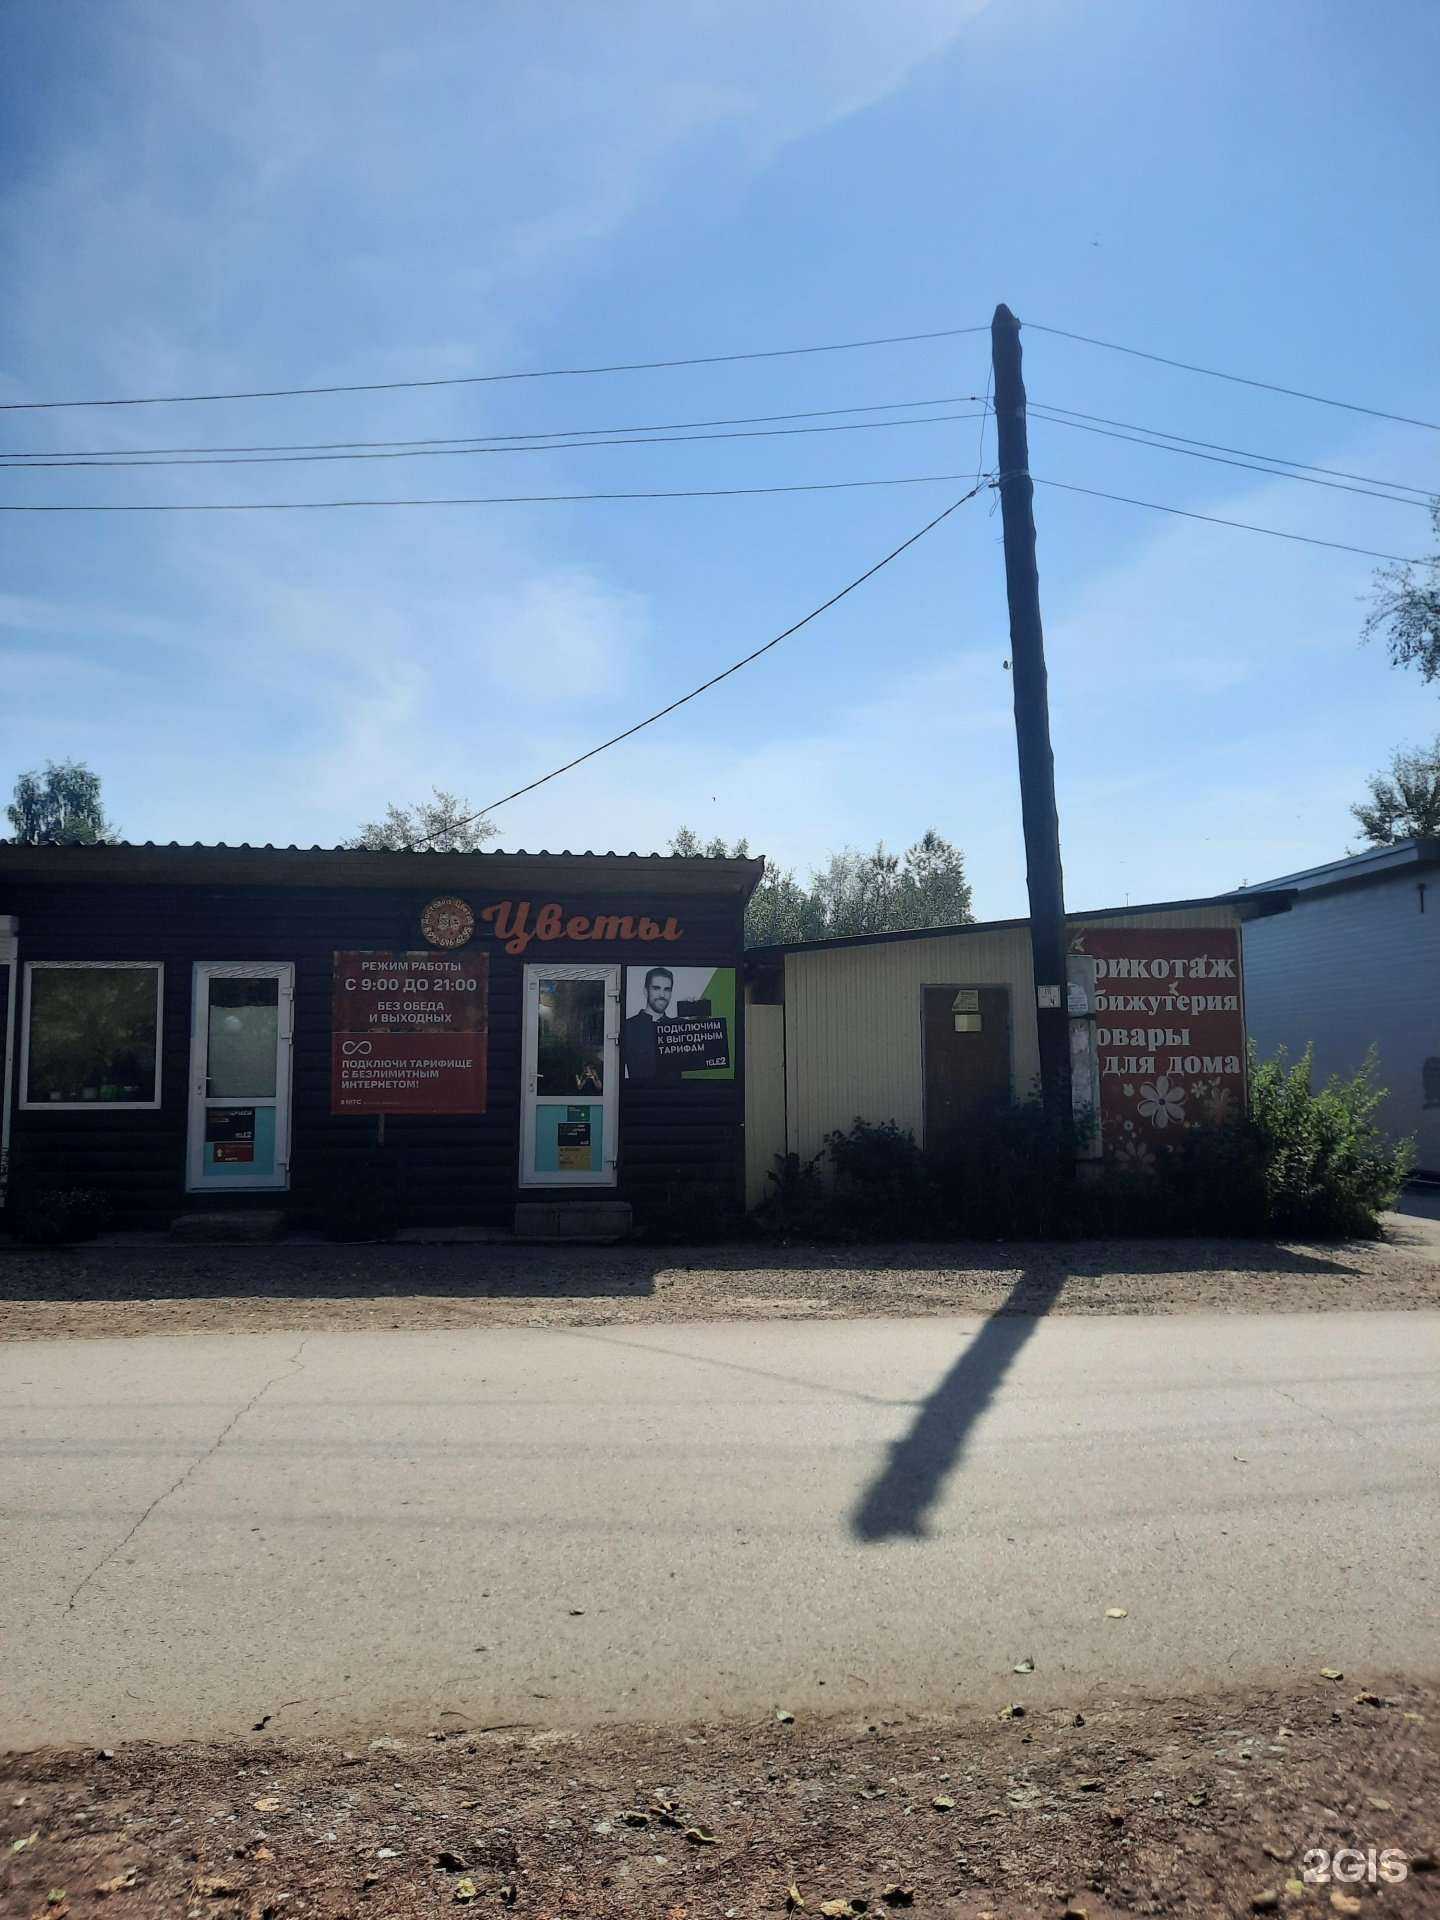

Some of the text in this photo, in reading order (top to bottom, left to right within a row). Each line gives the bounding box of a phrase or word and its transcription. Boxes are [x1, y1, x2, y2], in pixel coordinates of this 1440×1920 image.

[481, 901, 684, 955] Цветы
[361, 961, 461, 971] РЕЖИМ РАБОТЫ
[1094, 958, 1237, 984] рикотаж
[344, 978, 477, 993] С 9:00 ДО 21:00
[377, 1001, 445, 1012] БЕЗ ОБЕДА
[369, 1013, 452, 1024] И ВЫХОДНЫХ
[657, 1021, 721, 1034] ПОДКЛЮЧИМ
[657, 1032, 723, 1045] К ВЫГОДНЫМ
[1096, 1028, 1192, 1052] овары
[658, 1043, 705, 1055] ТАРИФАМ
[342, 1060, 473, 1070] ПОДКЛЮЧИ ТАРИФИЩЕ
[1103, 1055, 1241, 1077] для дома
[342, 1070, 440, 1079] С БЕЗЛИМИТНЫМ
[341, 1080, 419, 1089] ИНТЕРНЕТОМ!
